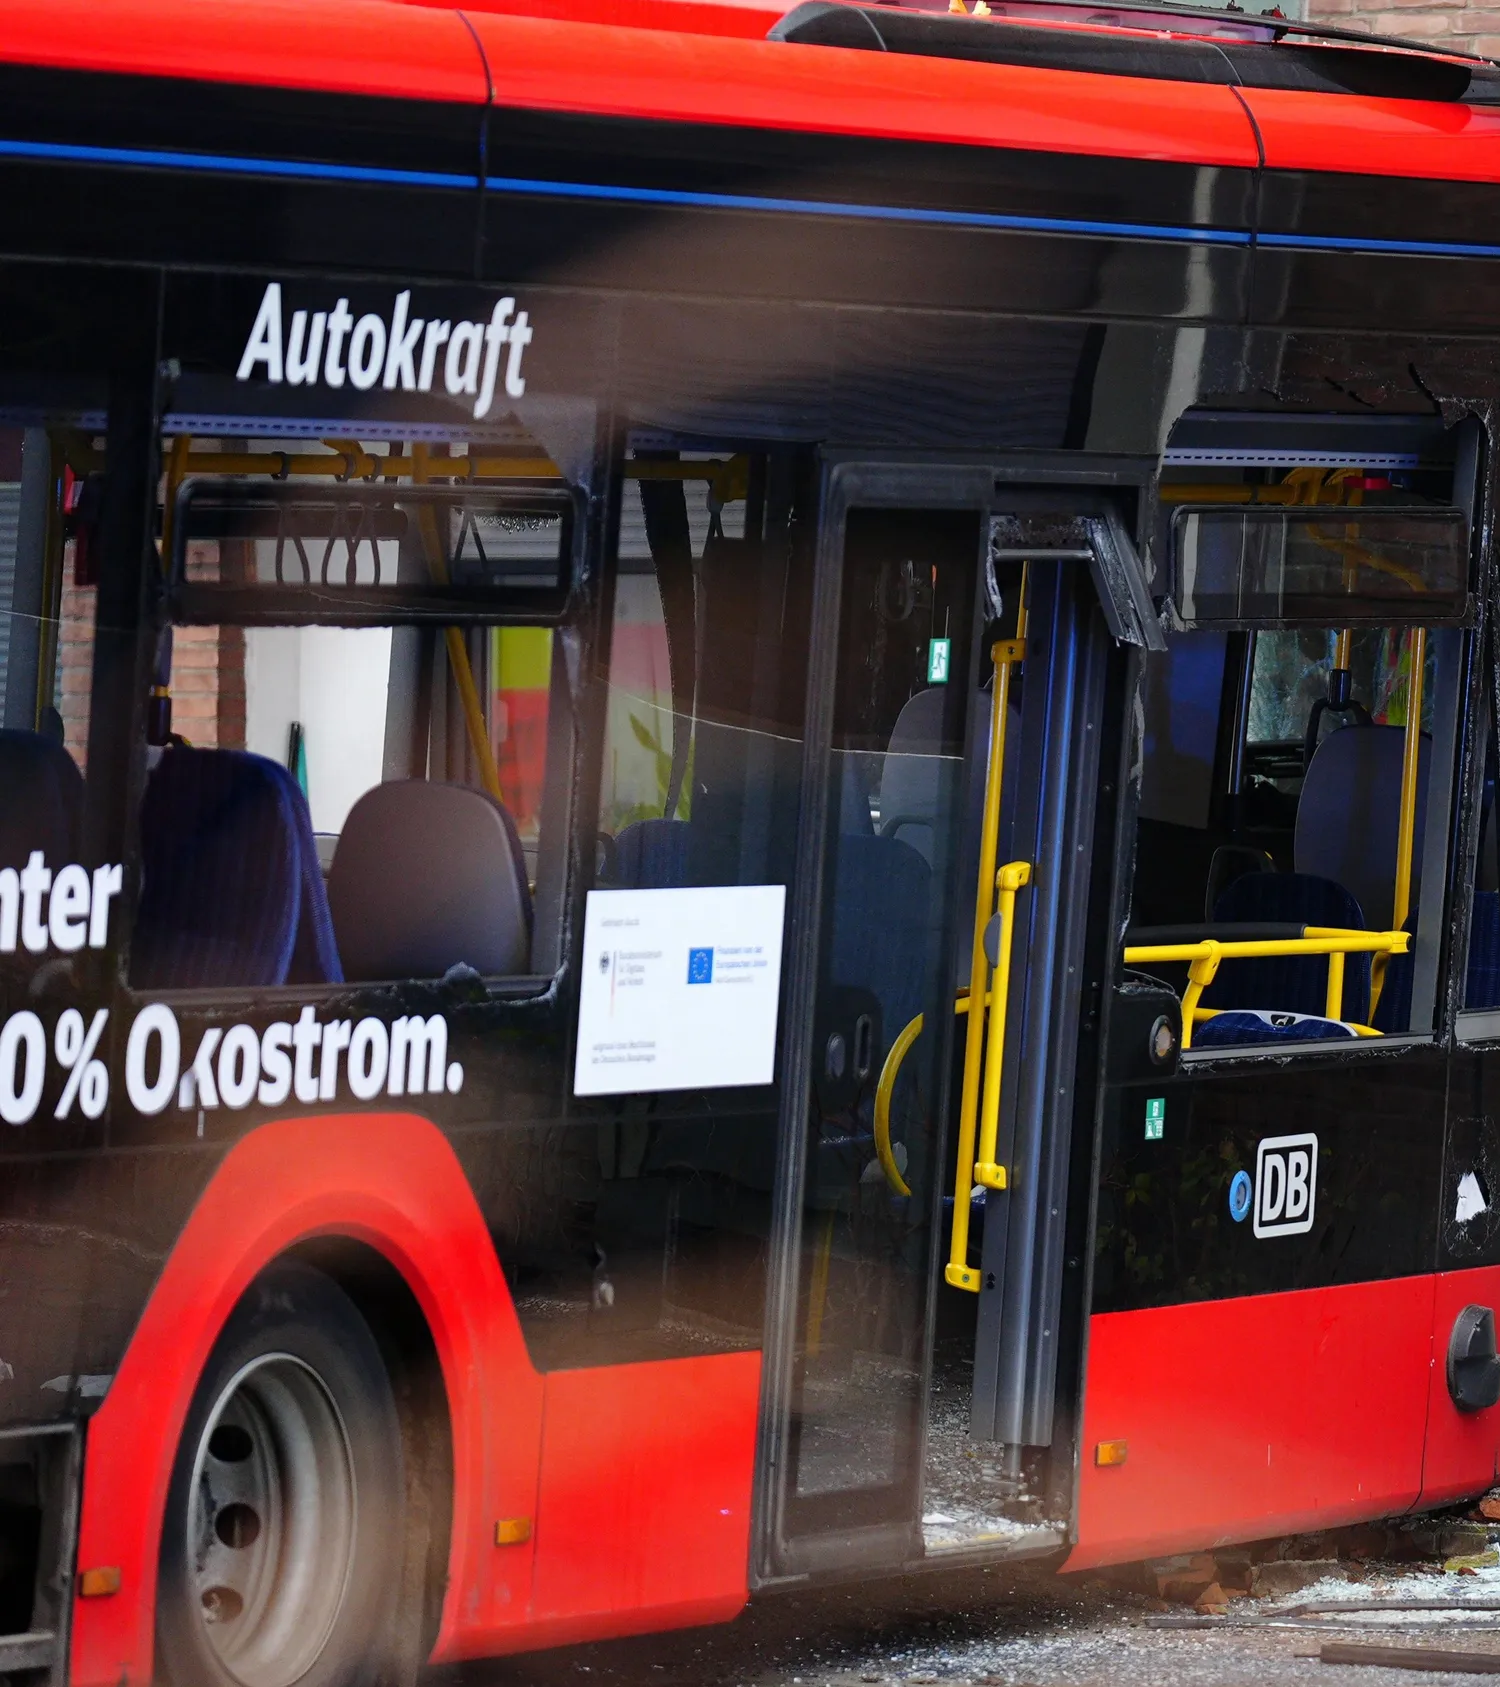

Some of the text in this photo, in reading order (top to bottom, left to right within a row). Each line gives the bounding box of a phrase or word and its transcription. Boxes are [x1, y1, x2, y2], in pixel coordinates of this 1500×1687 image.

[237, 283, 533, 419] Autokraft
[0, 1012, 45, 1122] 0
[55, 1009, 108, 1117] %
[1262, 1150, 1309, 1221] DB
